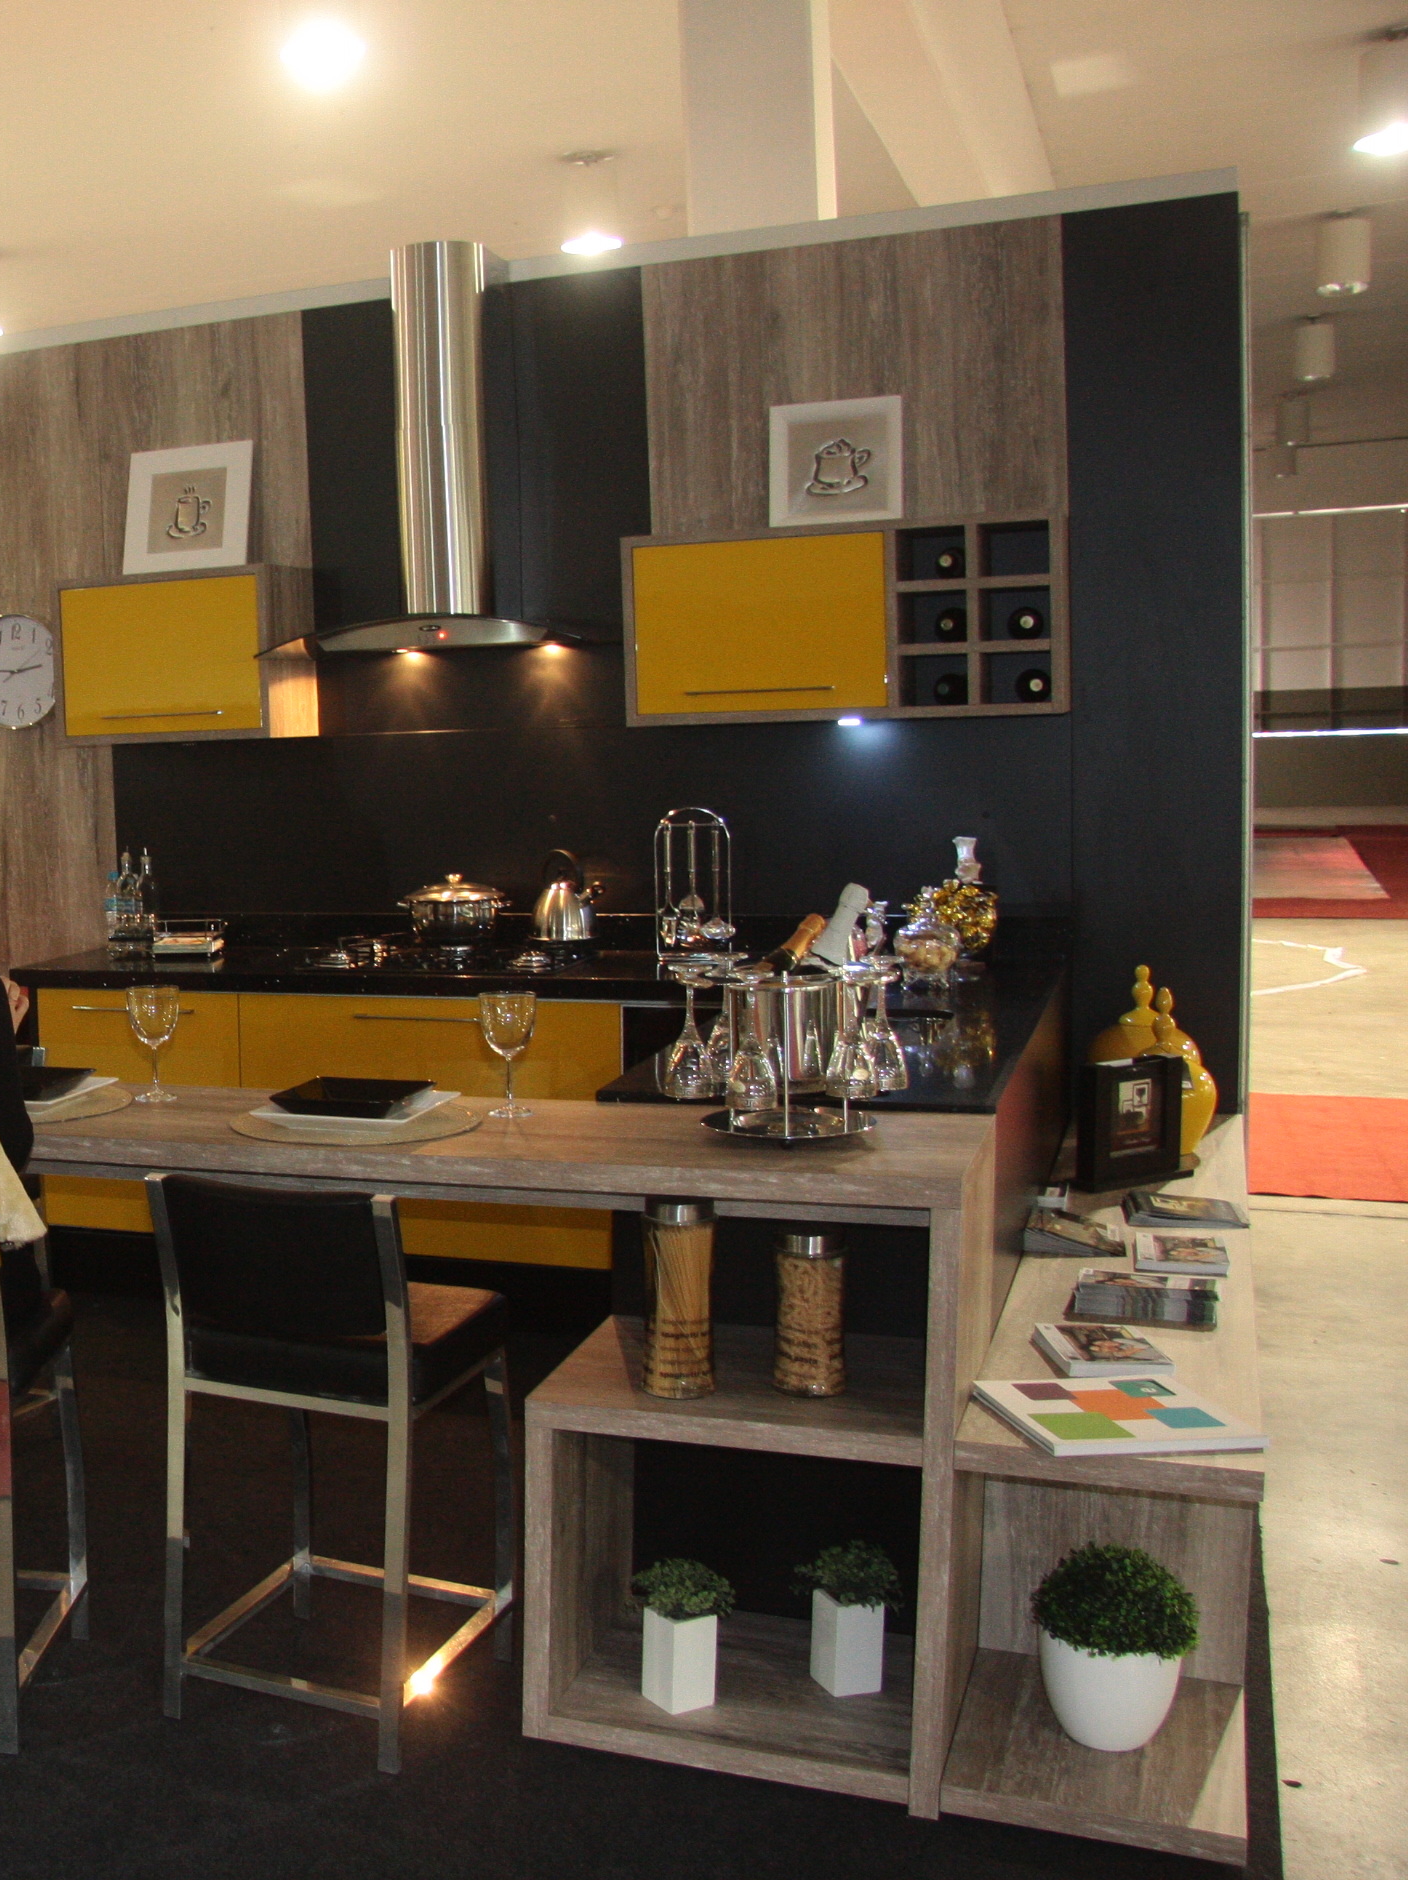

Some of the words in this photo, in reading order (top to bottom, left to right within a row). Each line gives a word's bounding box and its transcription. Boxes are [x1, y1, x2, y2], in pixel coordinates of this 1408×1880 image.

[12, 623, 21, 640] 12
[45, 638, 53, 655] 2
[1, 700, 7, 716] 7
[17, 703, 24, 723] 6
[34, 698, 41, 714] 5
